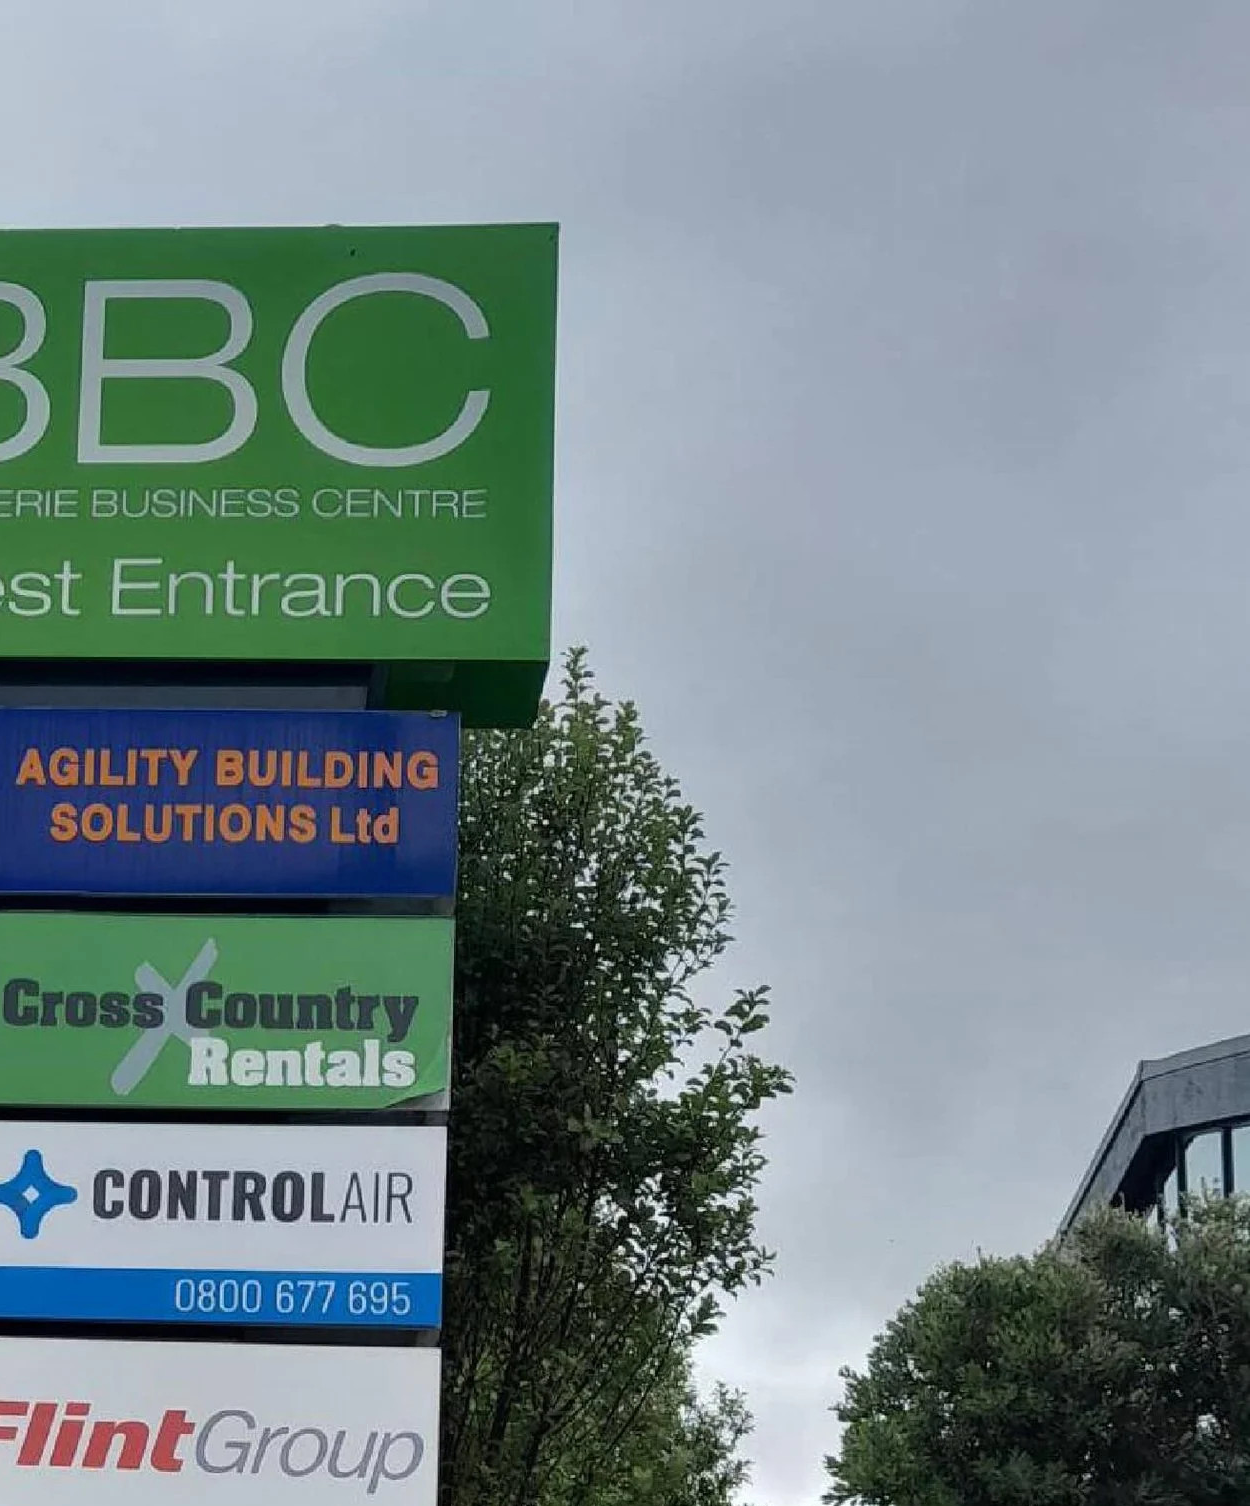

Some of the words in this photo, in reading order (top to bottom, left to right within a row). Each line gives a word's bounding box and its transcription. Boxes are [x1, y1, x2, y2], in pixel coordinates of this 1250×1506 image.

[92, 488, 301, 518] BUSINESS
[311, 488, 488, 518] CENTRE
[112, 556, 492, 619] Entrance
[15, 747, 198, 787] AGILITY
[215, 749, 440, 789] BUILDING
[50, 803, 317, 843] SOLUTIONS
[330, 807, 400, 845] Ltd
[3, 978, 165, 1028] Cross
[185, 981, 419, 1042] Country
[188, 1037, 416, 1087] Rentals
[92, 1169, 414, 1224] CONTROLAIR
[175, 1279, 262, 1314] 0800
[276, 1280, 336, 1315] 677
[349, 1281, 411, 1316] 695
